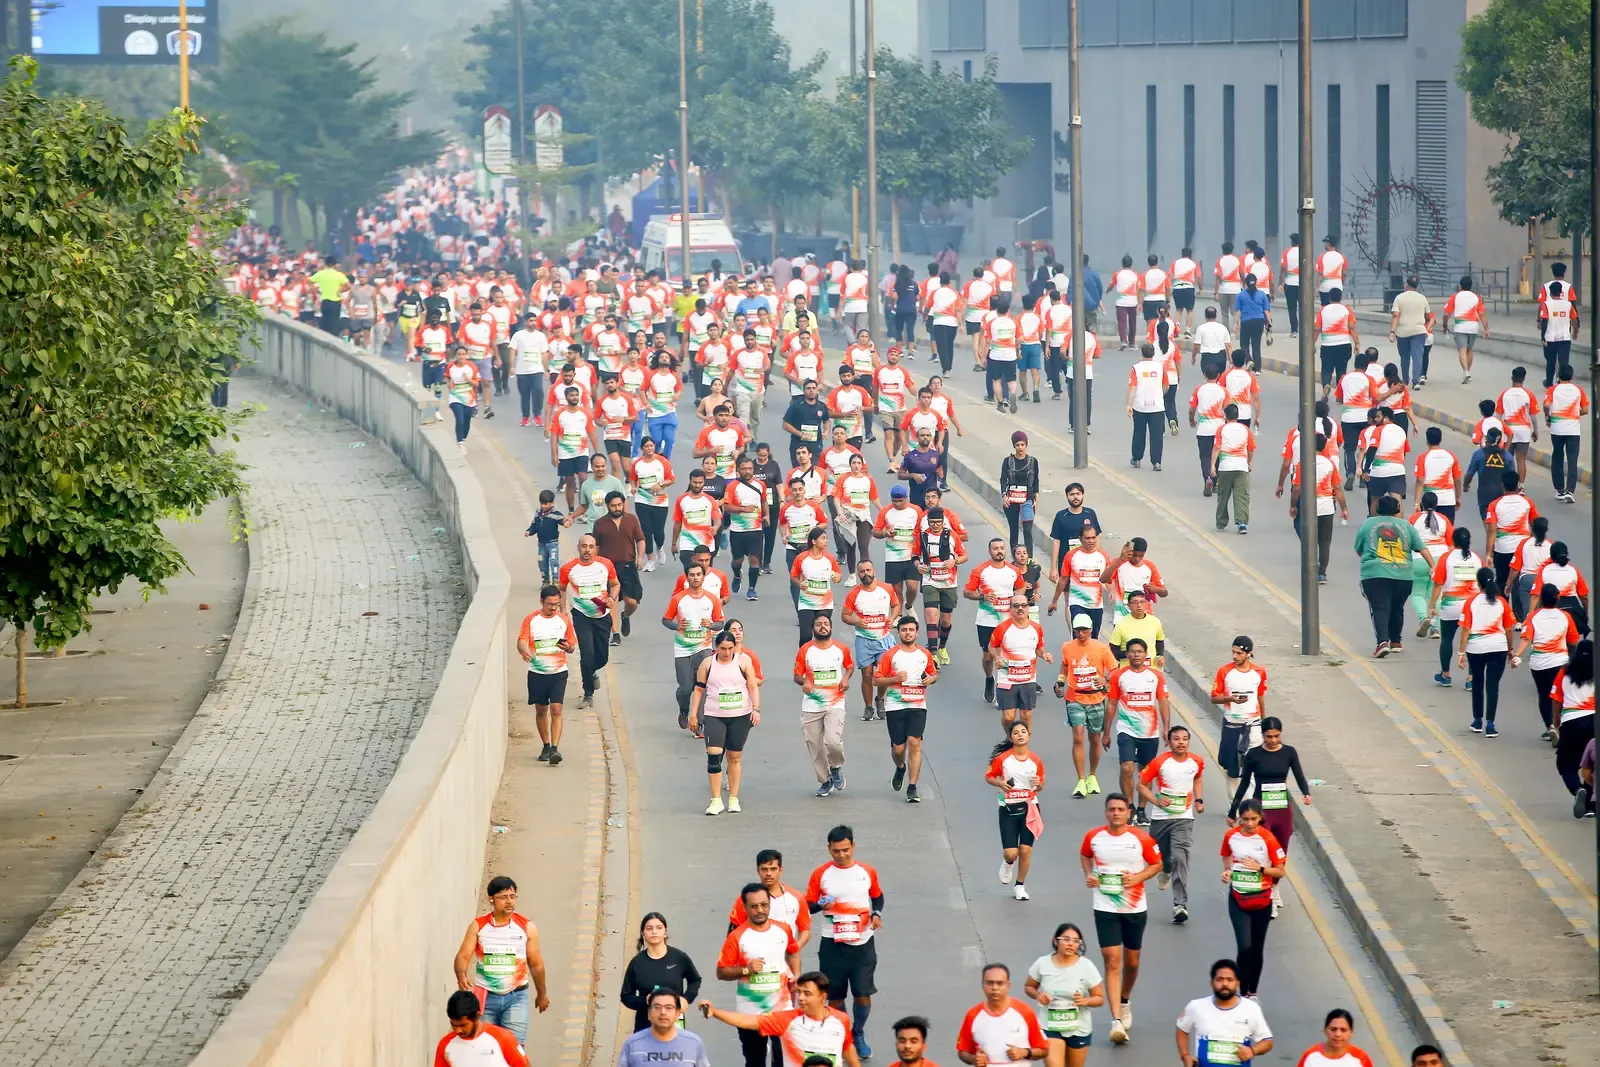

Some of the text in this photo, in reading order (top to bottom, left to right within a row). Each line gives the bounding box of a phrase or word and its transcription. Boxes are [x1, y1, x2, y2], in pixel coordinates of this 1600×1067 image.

[124, 14, 157, 25] Display
[1008, 791, 1028, 799] 25144
[1237, 874, 1259, 882] 17100
[837, 923, 857, 933] 21583
[489, 957, 512, 965] 12336
[755, 975, 777, 984] 13702
[648, 1052, 683, 1062] RUN
